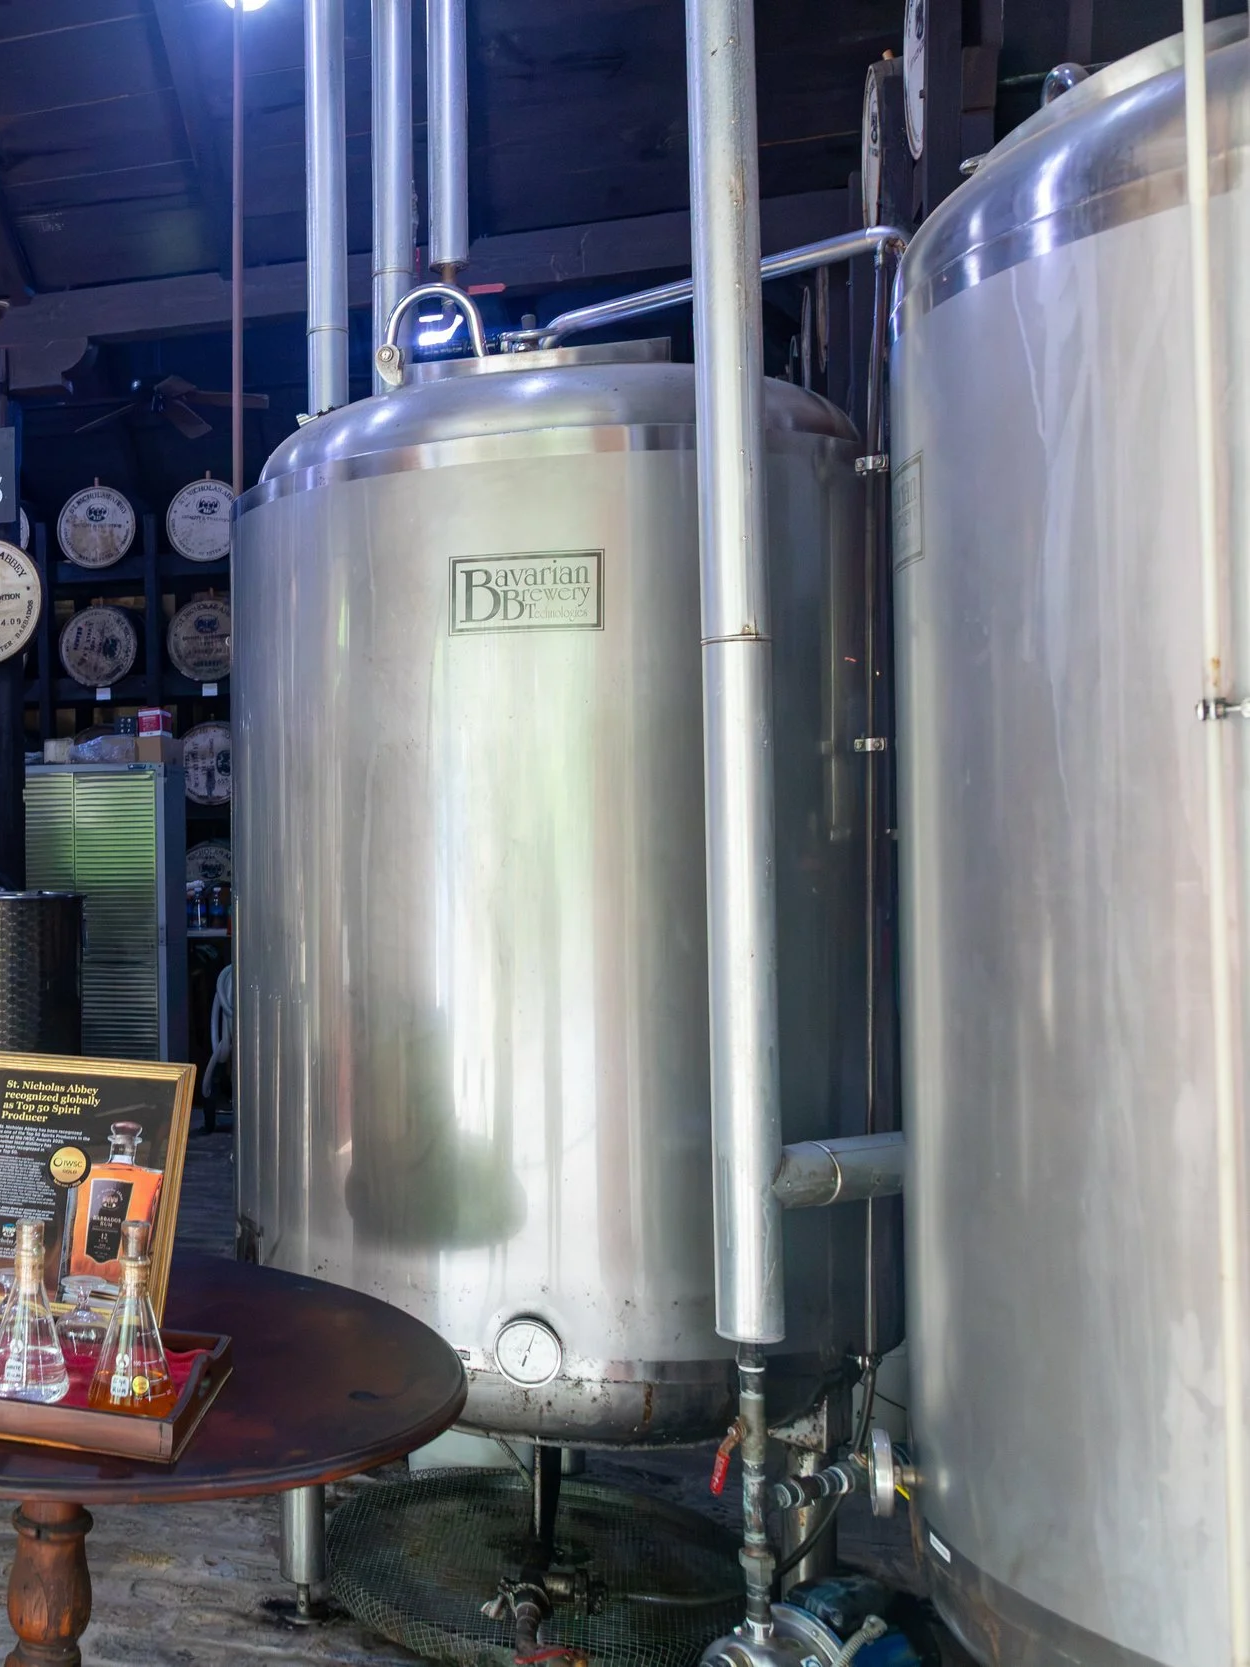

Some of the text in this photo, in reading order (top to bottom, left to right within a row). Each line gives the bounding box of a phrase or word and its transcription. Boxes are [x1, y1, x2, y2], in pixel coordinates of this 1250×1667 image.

[459, 559, 590, 624] Bavarian
[499, 586, 590, 621] Brewery
[14, 599, 34, 640] BARBADOS
[524, 603, 588, 621] Technologies
[6, 1080, 98, 1096] St. Nicholas Abbey
[5, 1092, 100, 1107] recognized globally
[16, 1101, 34, 1112] Top
[36, 1104, 50, 1113] 50
[52, 1104, 80, 1115] Spirit
[2, 1110, 48, 1122] Producer
[63, 1160, 83, 1168] IWSC
[92, 1215, 121, 1223] BARBADOS
